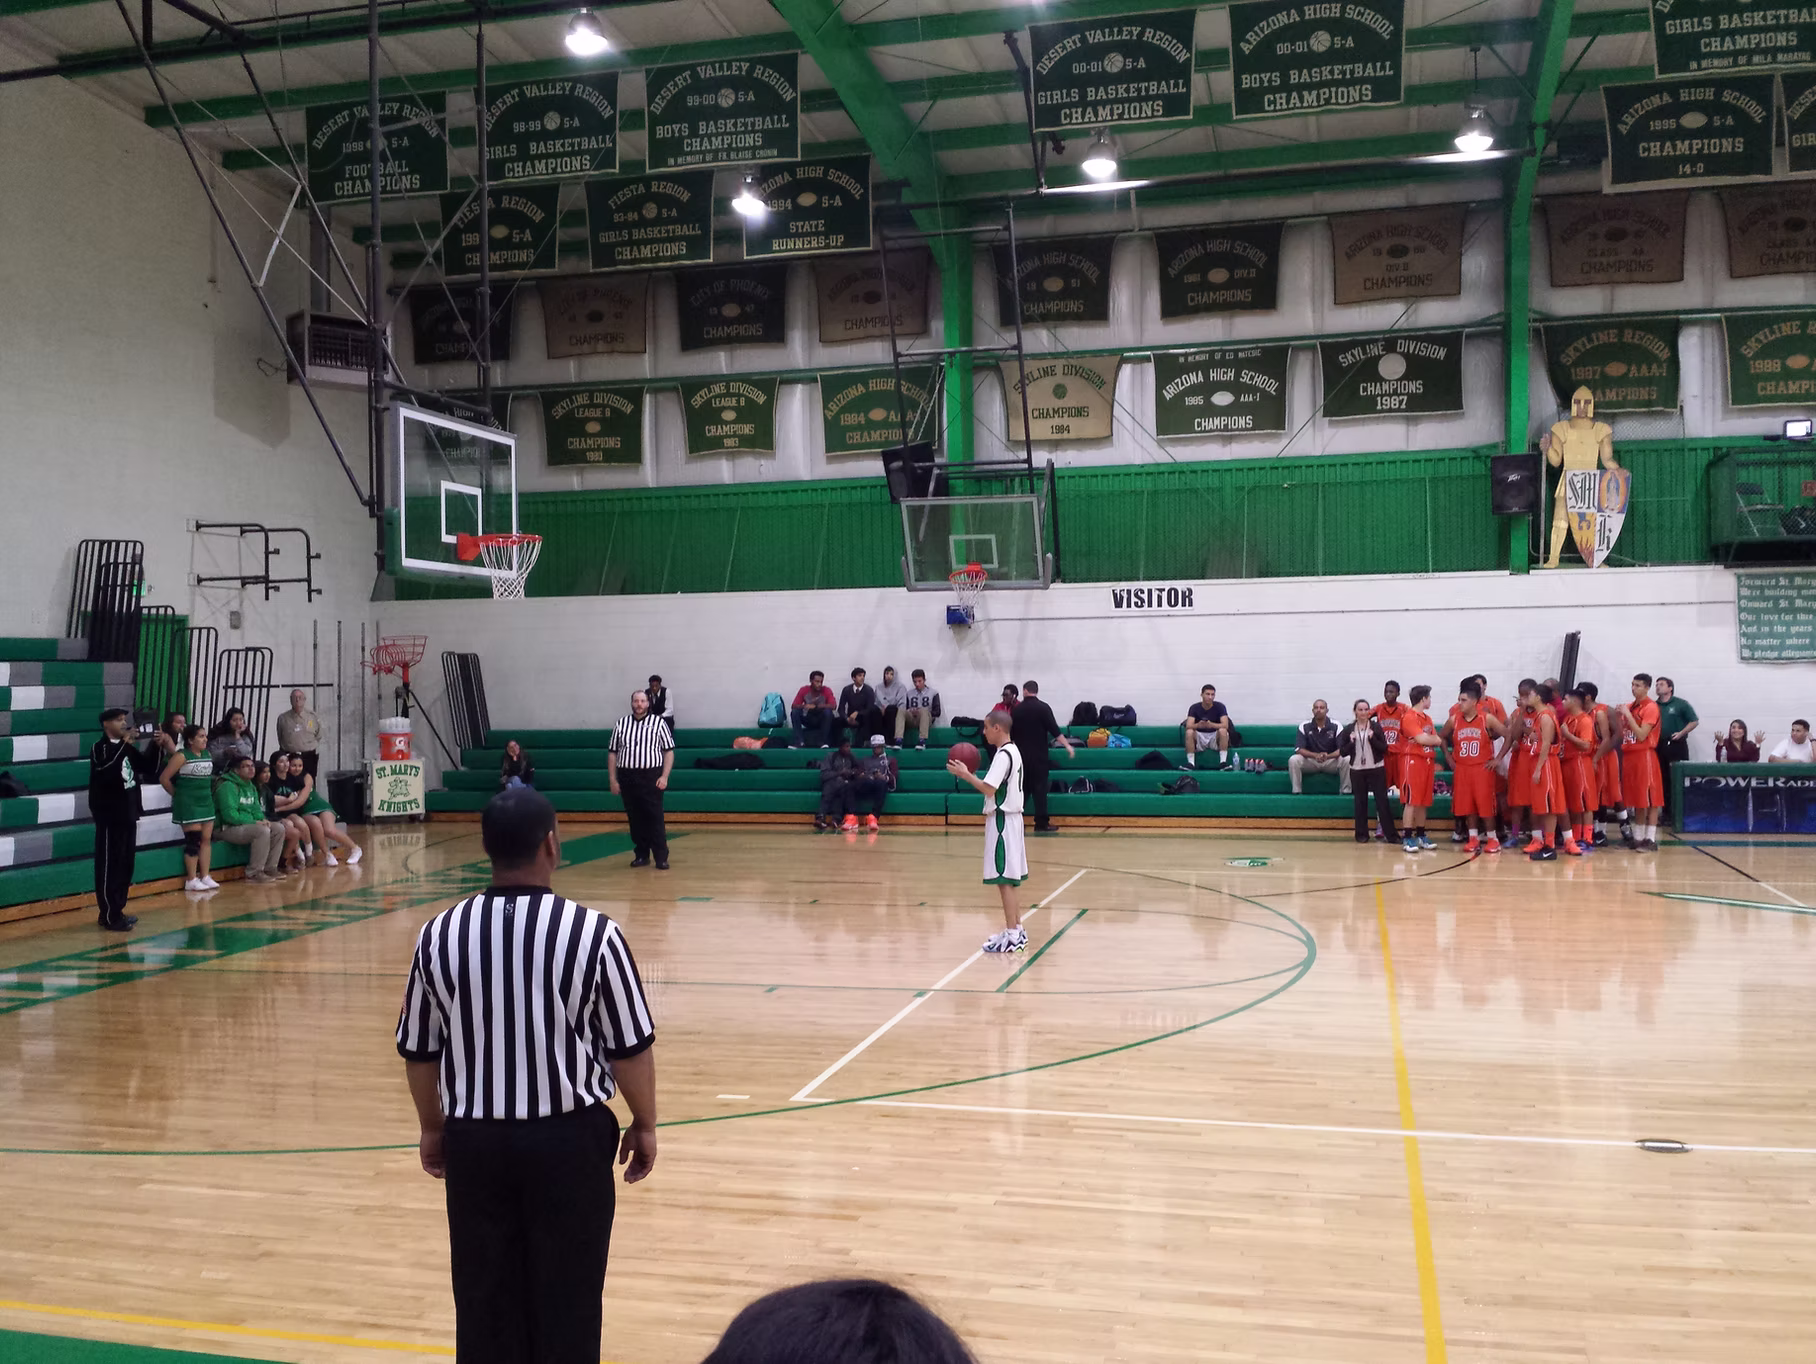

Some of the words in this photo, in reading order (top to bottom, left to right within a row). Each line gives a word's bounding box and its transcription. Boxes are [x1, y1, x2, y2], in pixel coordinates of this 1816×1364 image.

[1240, 9, 1300, 54] ARIZONA
[1304, 4, 1341, 19] HIGH
[1344, 5, 1395, 40] SCHOOL
[1665, 16, 1712, 35] GIRLS
[1720, 8, 1816, 29] BASKETBA
[1036, 34, 1081, 74] DESERT
[1085, 27, 1141, 44] VALLEY
[1143, 28, 1190, 63] REGION
[1701, 32, 1797, 52] CHAMPIONS
[1738, 55, 1747, 64] OF
[1242, 72, 1280, 88] BOYS
[1290, 61, 1393, 84] BASKETBALL
[650, 70, 692, 115] DESERT
[696, 62, 750, 78] VALLEY
[753, 65, 796, 102] REGION
[1038, 89, 1079, 105] GIRLS
[1087, 80, 1186, 100] BASKETBALL
[1264, 85, 1372, 110] CHAMPIONS
[485, 88, 520, 132] DESERT
[523, 82, 572, 98] VALLEY
[574, 84, 614, 120] REGION
[1061, 100, 1163, 124] CHAMPIONS
[1617, 92, 1673, 136] ARIZONA
[1679, 88, 1716, 101] HIGH
[1721, 89, 1767, 124] SCHOOL
[312, 110, 350, 150] DESERT
[354, 103, 400, 117] VALEY
[656, 123, 688, 138] BOYS
[699, 115, 789, 134] BASKETBALL
[529, 135, 612, 154] BASKETBALL
[684, 133, 762, 151] CHAMPIONS
[1638, 137, 1744, 157] CHAMPIONS
[505, 155, 590, 177] CHAMPIONS
[677, 154, 703, 164] MEMORY
[706, 153, 713, 161] OF
[345, 160, 409, 178] FOOBALL
[796, 166, 824, 178] HIGH
[828, 169, 864, 200] SCHOOL
[608, 184, 646, 209] FIESTA
[651, 181, 691, 203] REGION
[456, 197, 496, 229] FIESA
[501, 195, 545, 223] REGION
[599, 230, 628, 243] GIRLS
[632, 224, 701, 240] BASKETBALL
[790, 220, 824, 233] STATE
[615, 241, 686, 259] CHAMPIONS
[772, 235, 844, 250] RUNNERS-UP
[465, 249, 534, 265] CHMPIONS
[1168, 243, 1205, 279] ARIZONA
[1207, 240, 1231, 252] HIGH
[1234, 241, 1269, 268] SCHOOL
[1581, 258, 1654, 274] CHAMPIONS
[1043, 251, 1067, 264] HIGH
[1069, 254, 1100, 285] SCHOOL
[1364, 273, 1432, 290] CHAMPIONS
[1188, 288, 1252, 306] CHAMPIONS
[1024, 300, 1084, 315] CHAMPIONS
[569, 332, 624, 345] CHAMPIONS
[704, 324, 762, 338] CHAMPIONS
[1741, 321, 1800, 357] SKYLINE
[1338, 342, 1386, 367] SKYLINE
[1397, 340, 1447, 360] DIVISION
[1561, 329, 1618, 365] SKYLINE
[1624, 329, 1670, 360] REGION
[1063, 364, 1106, 390] DIVISION
[1163, 370, 1204, 400] ARIZONA
[1210, 368, 1235, 381] HIGH
[1240, 370, 1279, 395] SCHOOL
[691, 382, 726, 408] SKYLINE
[730, 382, 767, 404] DIVISION
[1360, 381, 1423, 396] CHAMPIONS
[552, 392, 590, 419] SKYLINE
[594, 392, 634, 414] DIVISION
[712, 397, 738, 407] LEAGUE
[825, 383, 866, 420] ARIZONA
[869, 379, 894, 391] HIGH
[1376, 396, 1408, 410] 1987
[575, 408, 603, 417] LEAGUE
[1032, 406, 1089, 419] CHAMPIONS
[705, 424, 754, 436] CHAMPIONS
[1195, 416, 1252, 431] CHAMPIONS
[568, 437, 621, 448] CHAMPIONS
[1112, 587, 1193, 608] VISITOR
[1460, 741, 1479, 756] 30
[376, 768, 389, 778] ST.
[378, 798, 420, 812] KNIGHTS
